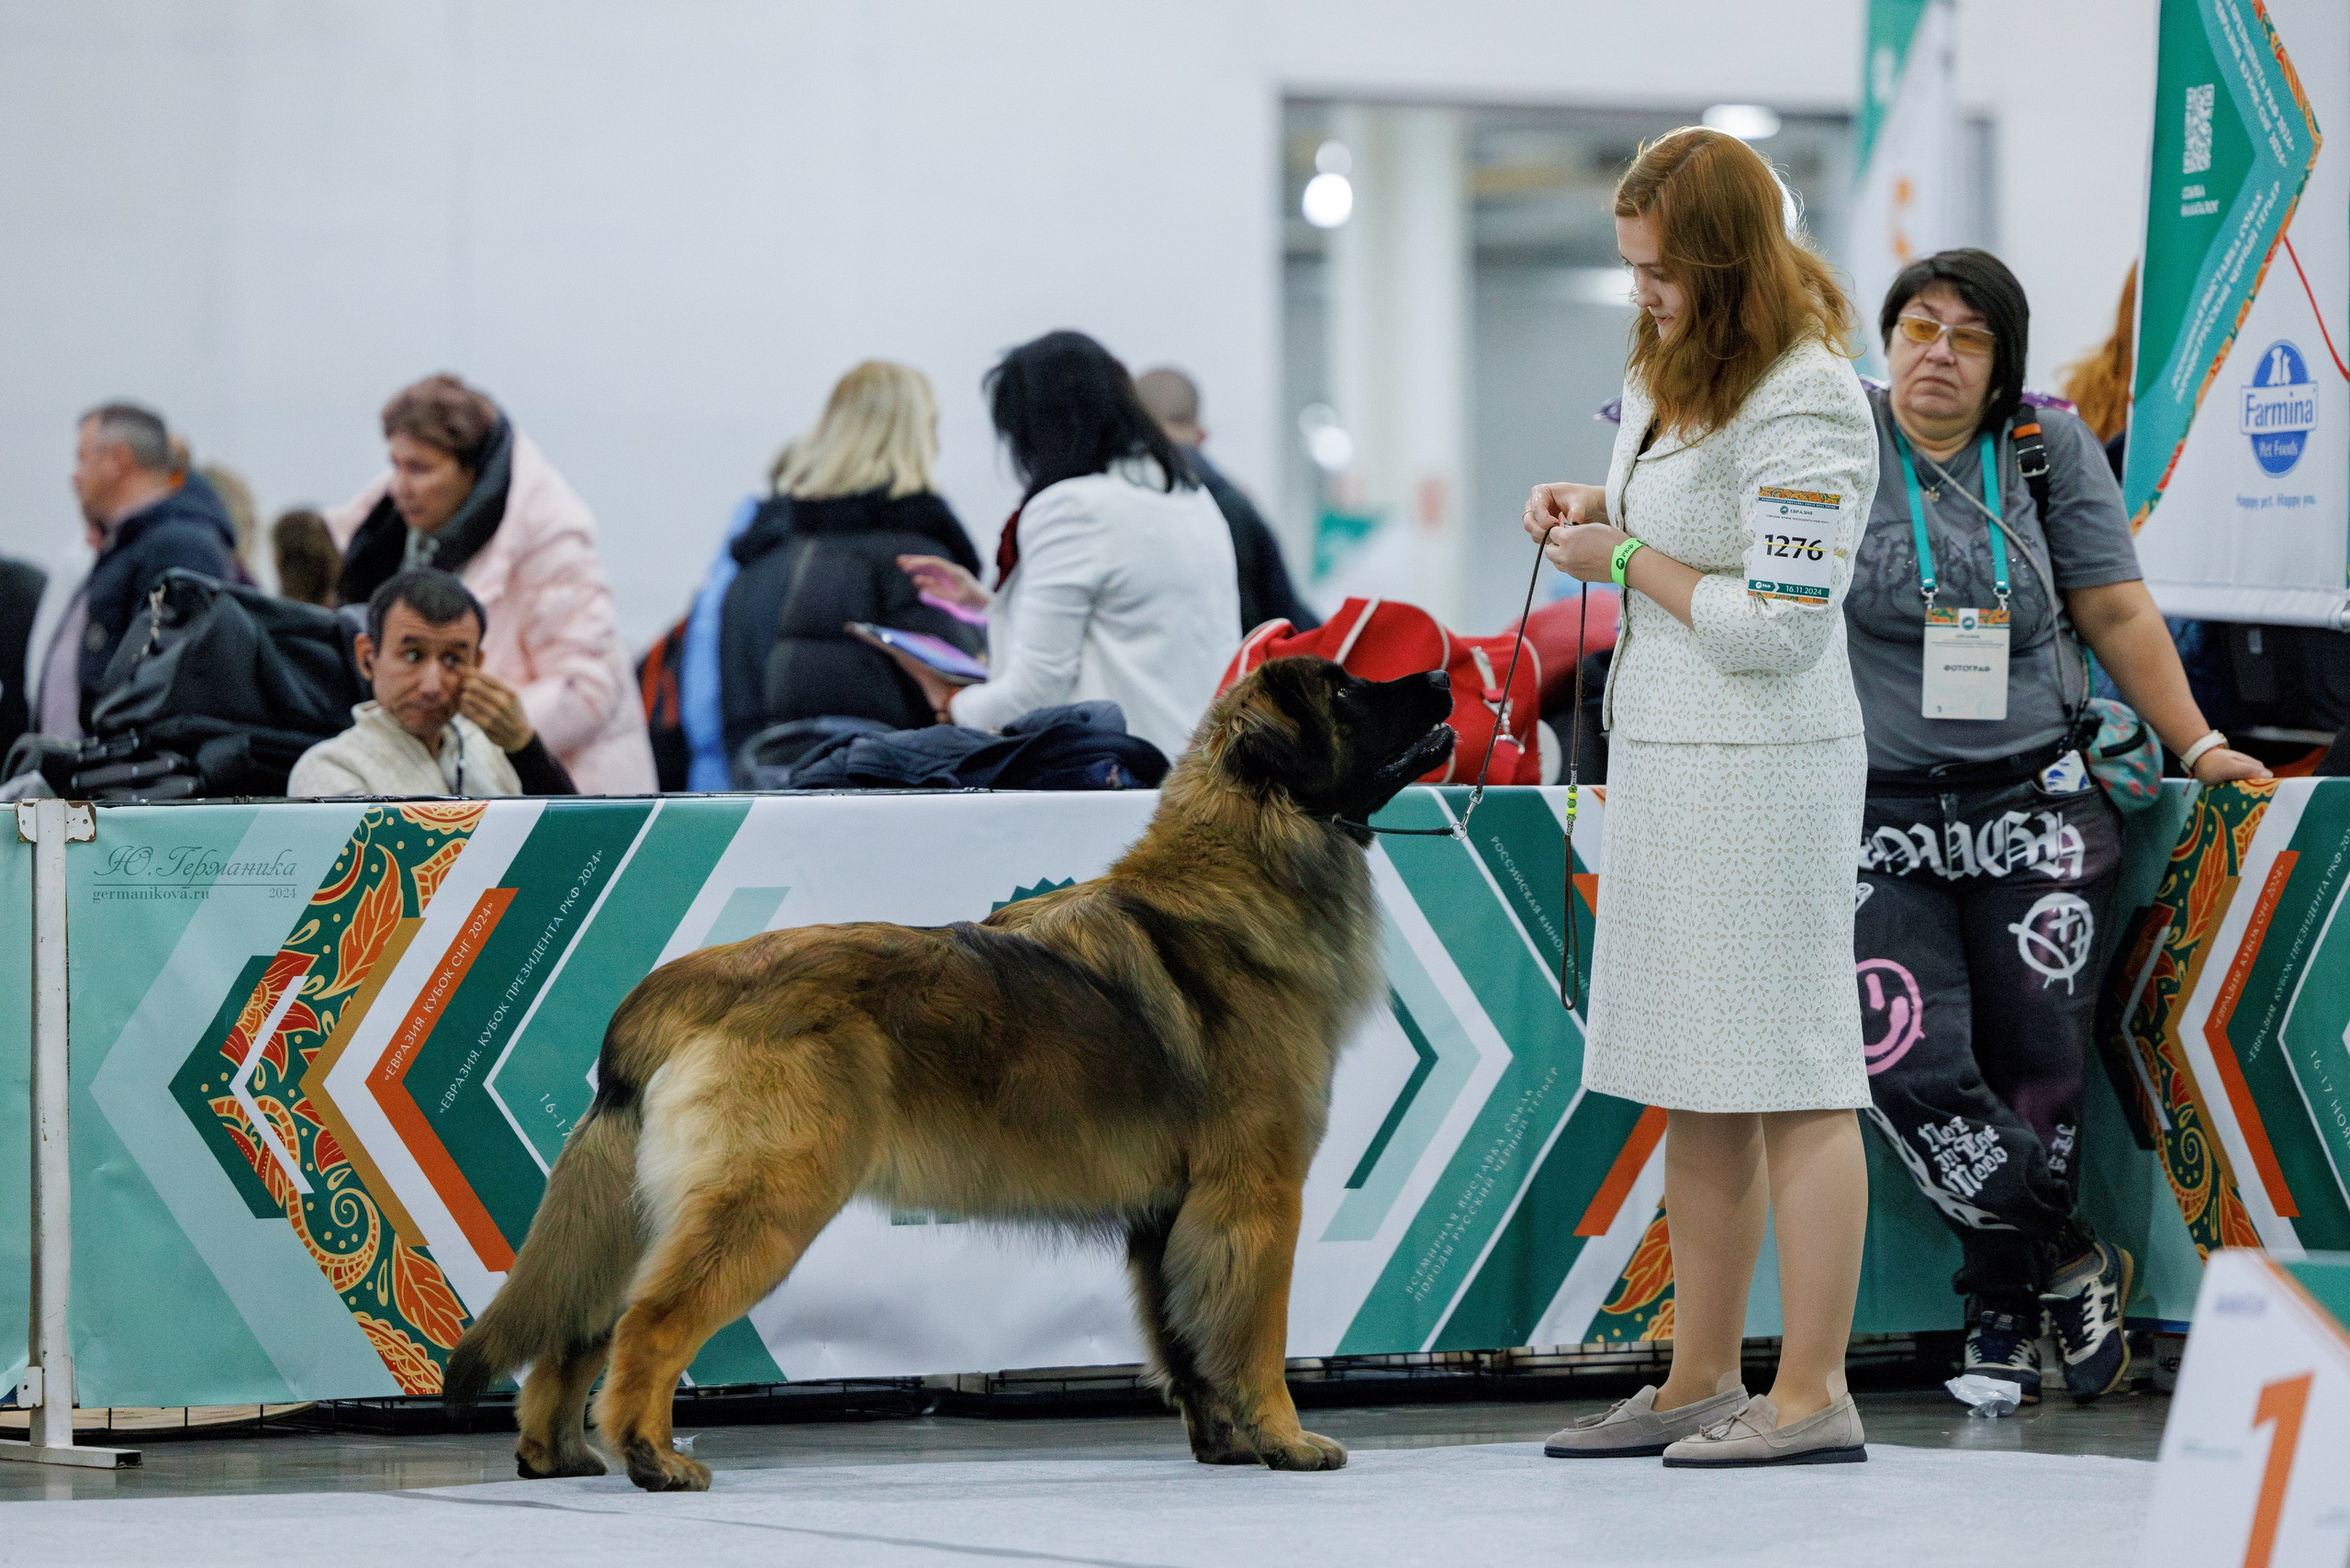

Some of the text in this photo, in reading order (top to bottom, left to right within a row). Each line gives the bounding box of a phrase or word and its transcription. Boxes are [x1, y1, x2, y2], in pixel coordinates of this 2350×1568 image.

[2245, 390, 2314, 428] Farmina
[1764, 533, 1824, 561] 1276
[1785, 585, 1822, 596] 16.11.2024
[1943, 664, 1991, 672] ФОТОГРАФ
[1490, 835, 1542, 914] РОССИЙСКАЯ
[385, 902, 493, 1081] «ЕВРАЗИЯ. КУБОК СНГ 2024»
[440, 849, 603, 1114] «ЕВРАЗИЯ. КУБОК ПРЕЗИДЕНТА РКФ 2024»
[2310, 1050, 2333, 1092] 16-17
[1459, 1137, 1505, 1209] ВЫСТАВКА
[1504, 1089, 1534, 1133] СОБАК
[1451, 1177, 1495, 1242] РУССКИЙ
[2244, 1370, 2316, 1568] 1
